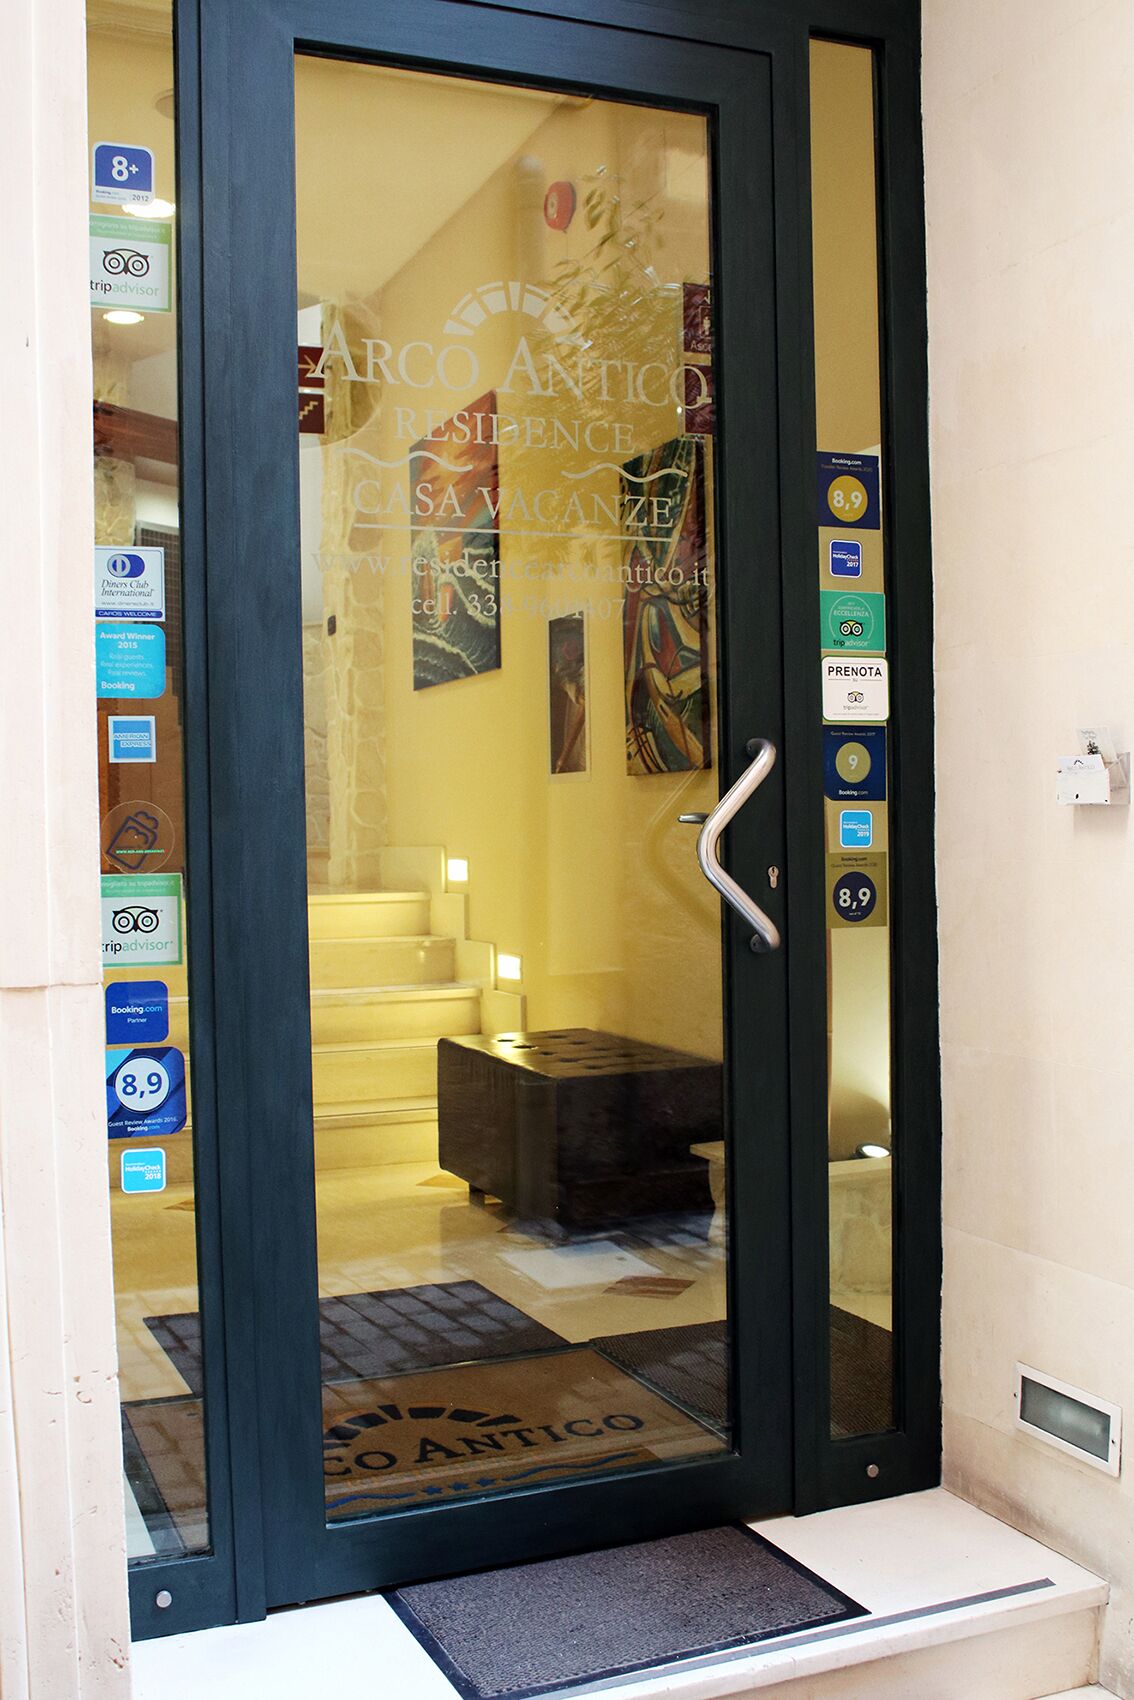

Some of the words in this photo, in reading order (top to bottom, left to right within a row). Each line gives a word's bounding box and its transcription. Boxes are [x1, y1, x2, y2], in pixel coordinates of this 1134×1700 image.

[111, 155, 139, 182] 8+
[132, 194, 150, 202] 2012
[90, 279, 160, 297] tripadvisor
[393, 406, 635, 454] RESIDENCE
[831, 457, 862, 466] Booking.com
[353, 479, 466, 518] CASA
[477, 486, 674, 528] VACANZE
[833, 489, 863, 511] 8,9
[101, 579, 128, 588] Diners
[130, 580, 149, 589] Club
[101, 588, 153, 597] International
[833, 609, 869, 617] ECCELLENZA
[100, 632, 126, 640] Award
[127, 632, 156, 640] Winner
[118, 641, 138, 649] 2015
[833, 639, 869, 648] tripadvisor
[828, 665, 883, 678] PRENOTA
[101, 681, 136, 692] Booking
[848, 755, 858, 770] 9
[838, 887, 871, 910] 8,9
[111, 1005, 163, 1015] Booking.com
[122, 1071, 163, 1099] 8,9
[108, 1120, 124, 1128] Guest
[124, 1119, 143, 1127] Review
[414, 1413, 646, 1465] ANTICO
